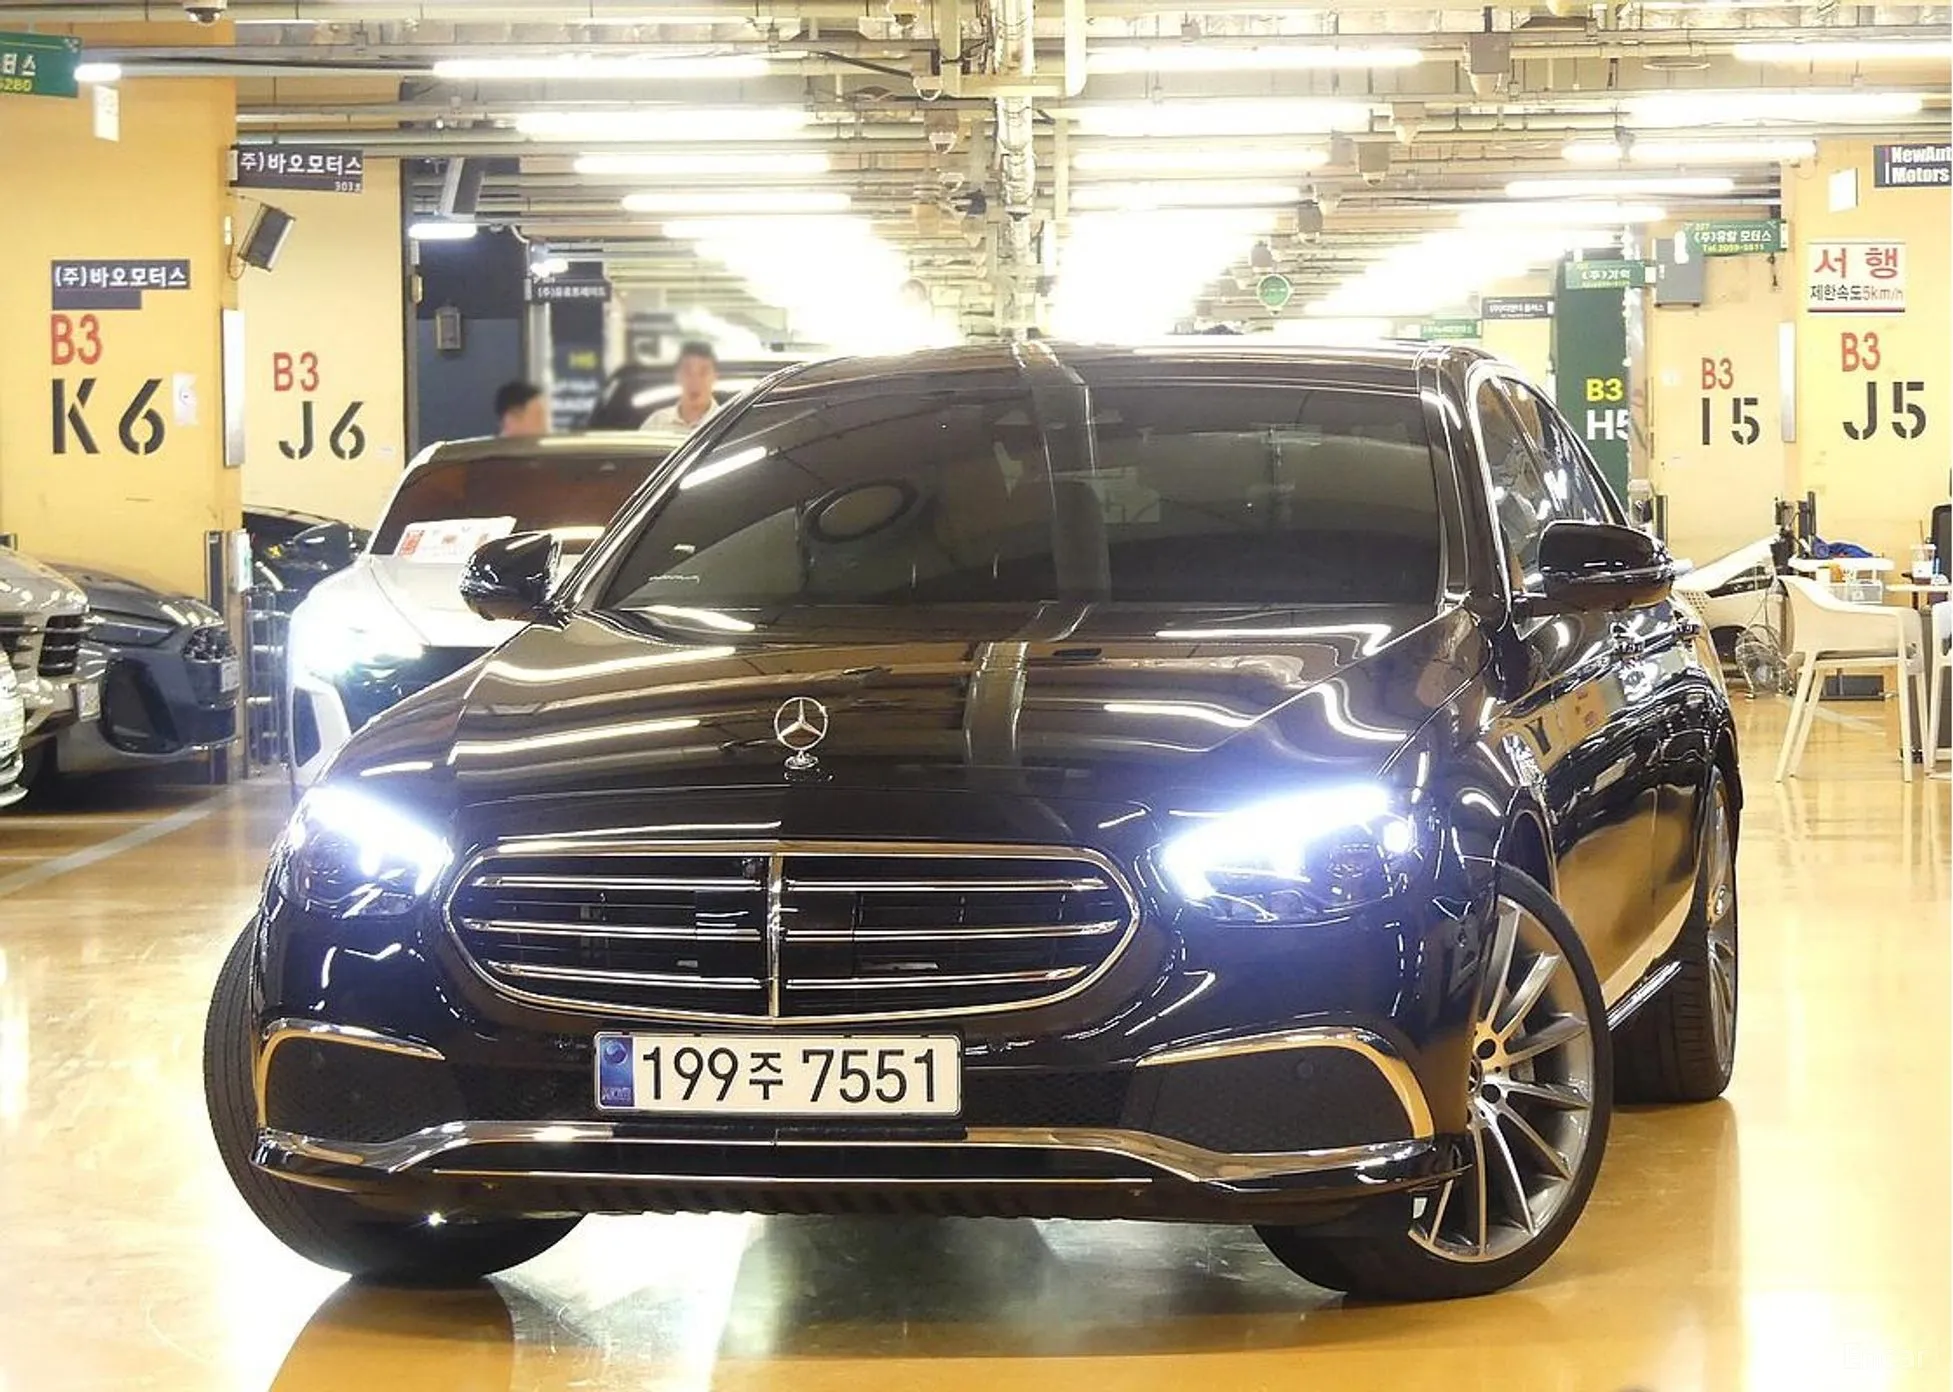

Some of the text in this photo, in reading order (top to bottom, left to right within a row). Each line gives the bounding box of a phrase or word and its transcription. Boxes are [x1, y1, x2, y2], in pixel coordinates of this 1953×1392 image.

[1891, 166, 1951, 185] Motors
[1740, 229, 1772, 242] 모터스
[54, 265, 188, 288] (주)바오모터스
[50, 314, 102, 366] B3
[1841, 332, 1881, 371] B3
[273, 352, 319, 392] B3
[1701, 357, 1734, 390] B3
[1586, 378, 1623, 402] B3
[643, 1047, 935, 1103] 199주 7551
